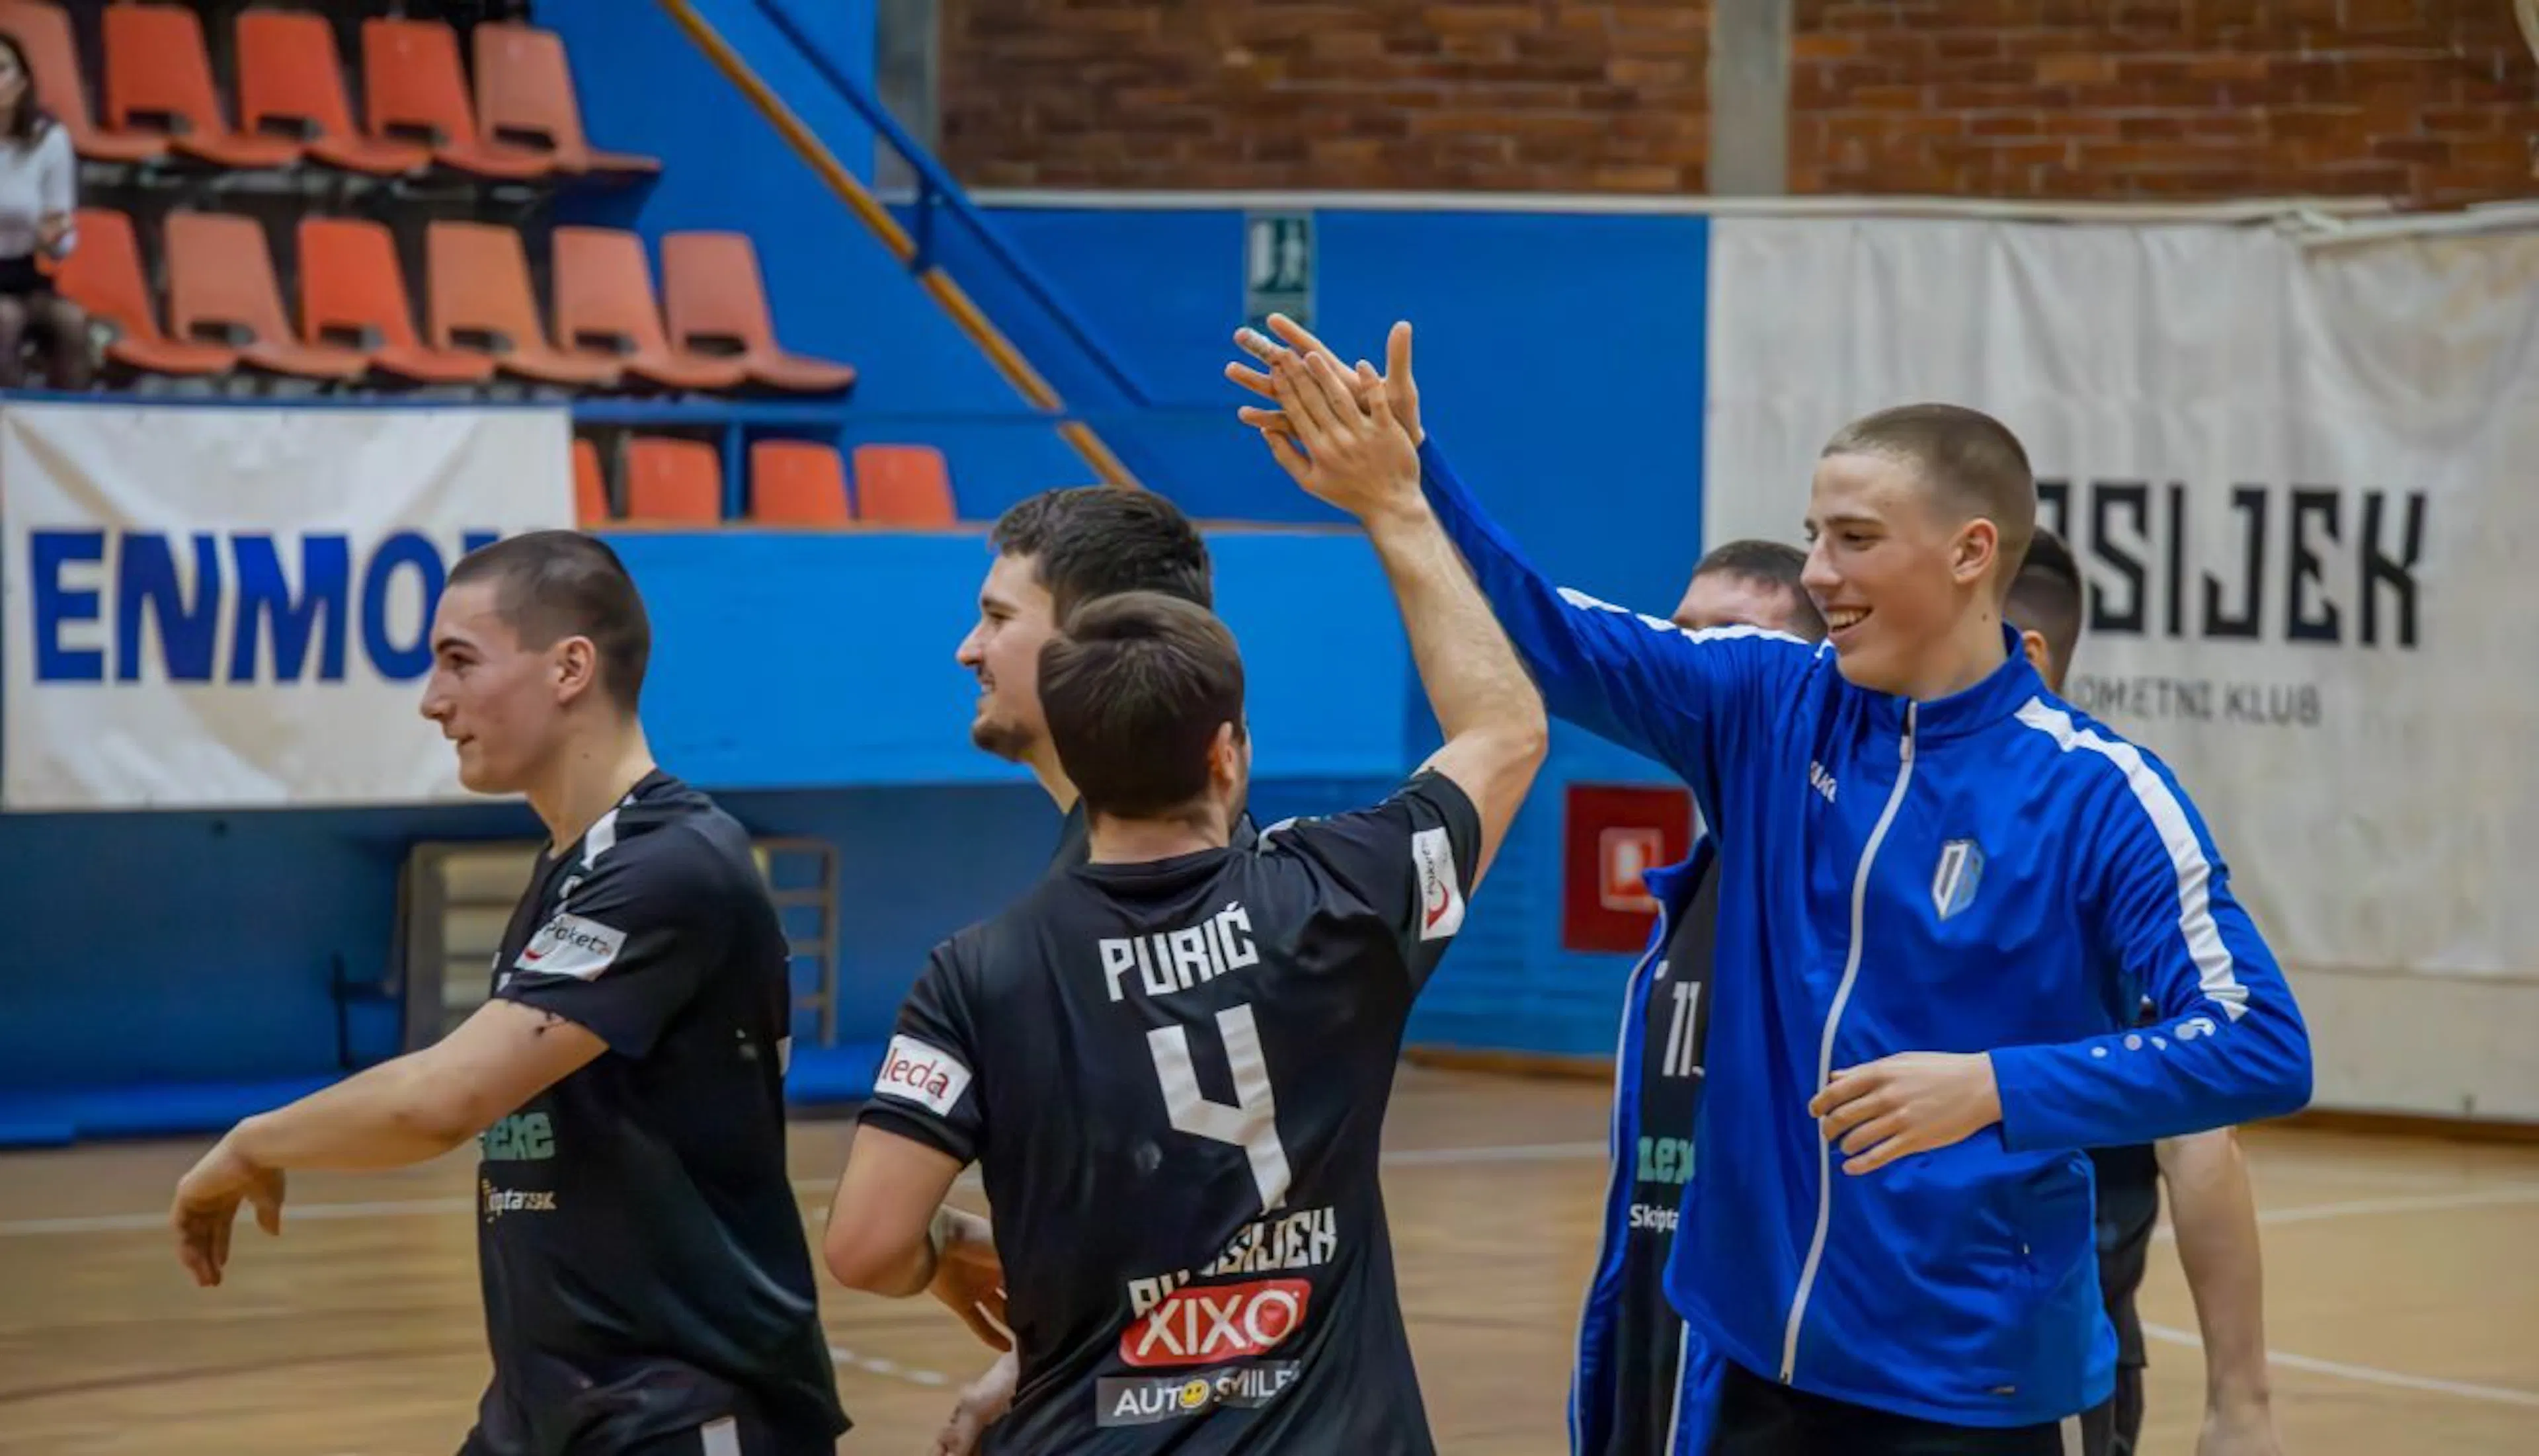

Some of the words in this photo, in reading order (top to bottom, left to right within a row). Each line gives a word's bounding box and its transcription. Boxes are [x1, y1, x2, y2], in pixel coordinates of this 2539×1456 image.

[28, 530, 500, 683] ENMO
[2226, 682, 2321, 727] KLUB
[1099, 901, 1259, 1002] PURIĆ
[882, 1047, 949, 1099] leda
[1146, 1002, 1291, 1215] 4
[1197, 1207, 1338, 1277] SIJEK
[1137, 1289, 1298, 1356] XIXO
